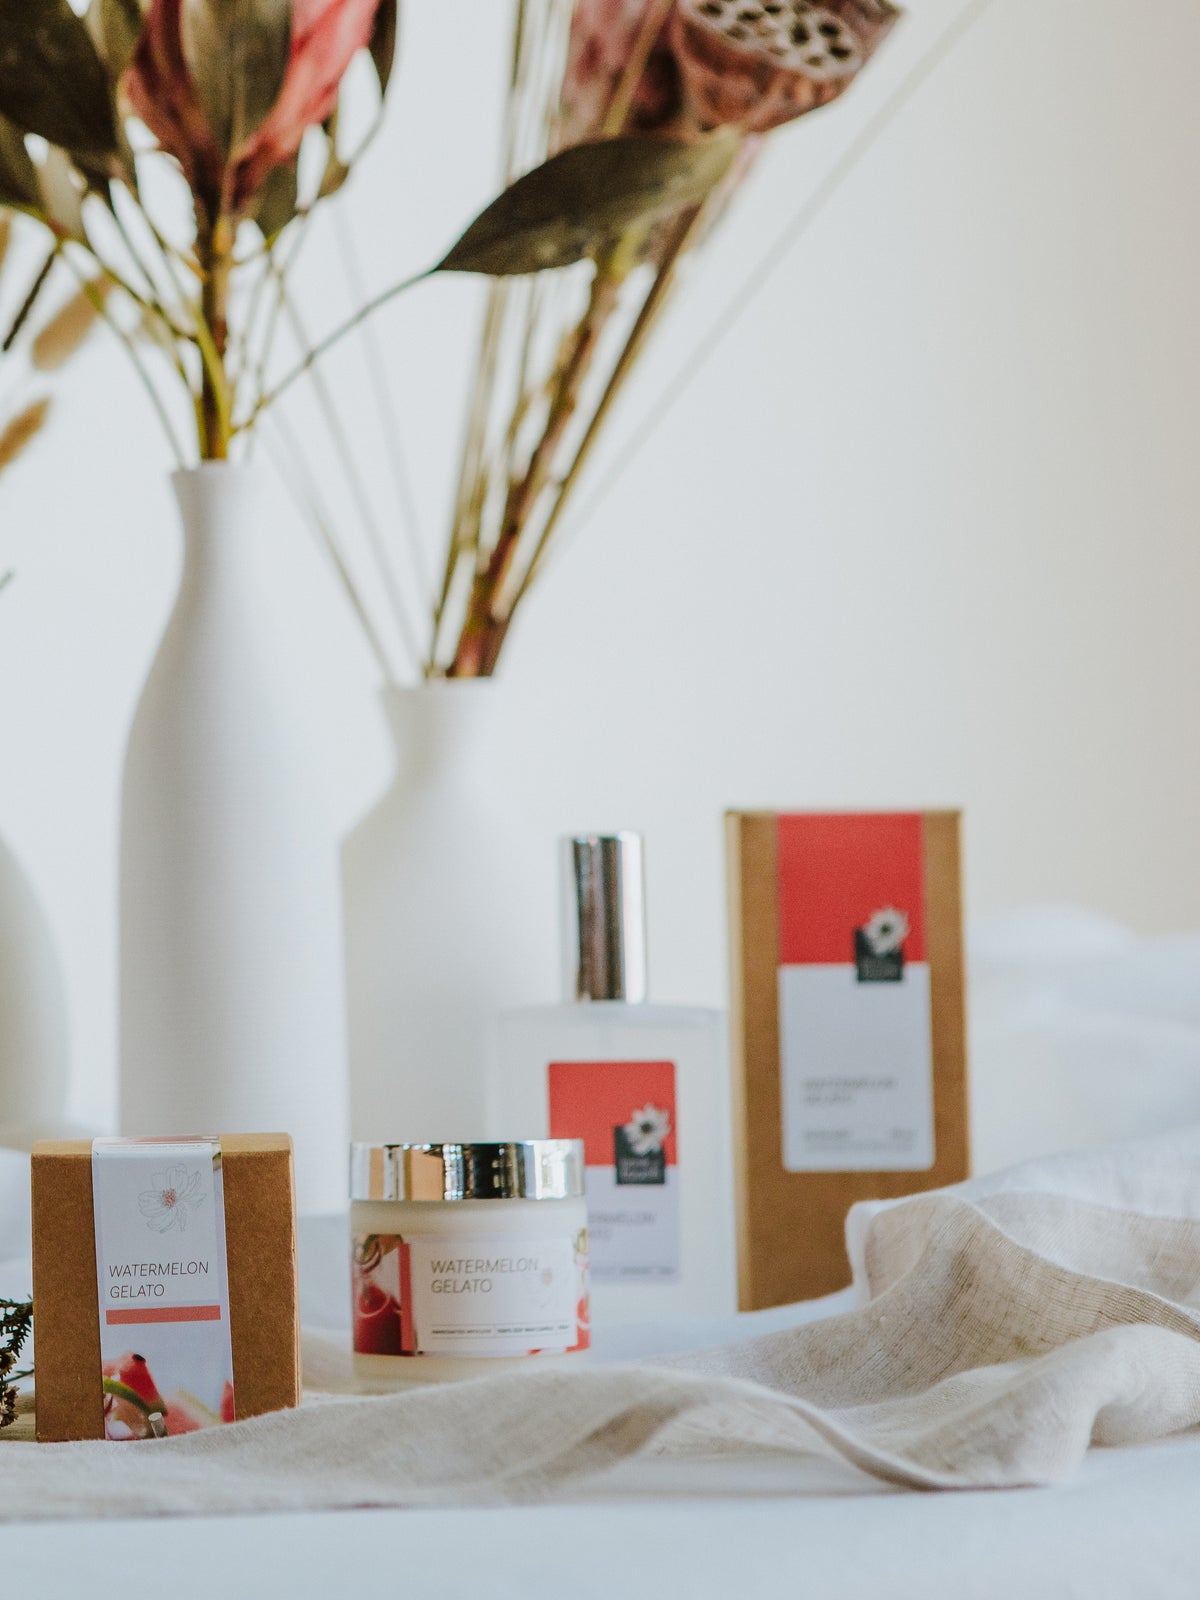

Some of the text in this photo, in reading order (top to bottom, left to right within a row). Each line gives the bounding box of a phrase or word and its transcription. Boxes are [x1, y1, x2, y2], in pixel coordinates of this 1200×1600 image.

[109, 1261, 209, 1278] WATERMELON
[431, 1258, 538, 1274] WATERMELON
[110, 1284, 165, 1299] GELATO
[431, 1278, 492, 1293] GELATO
